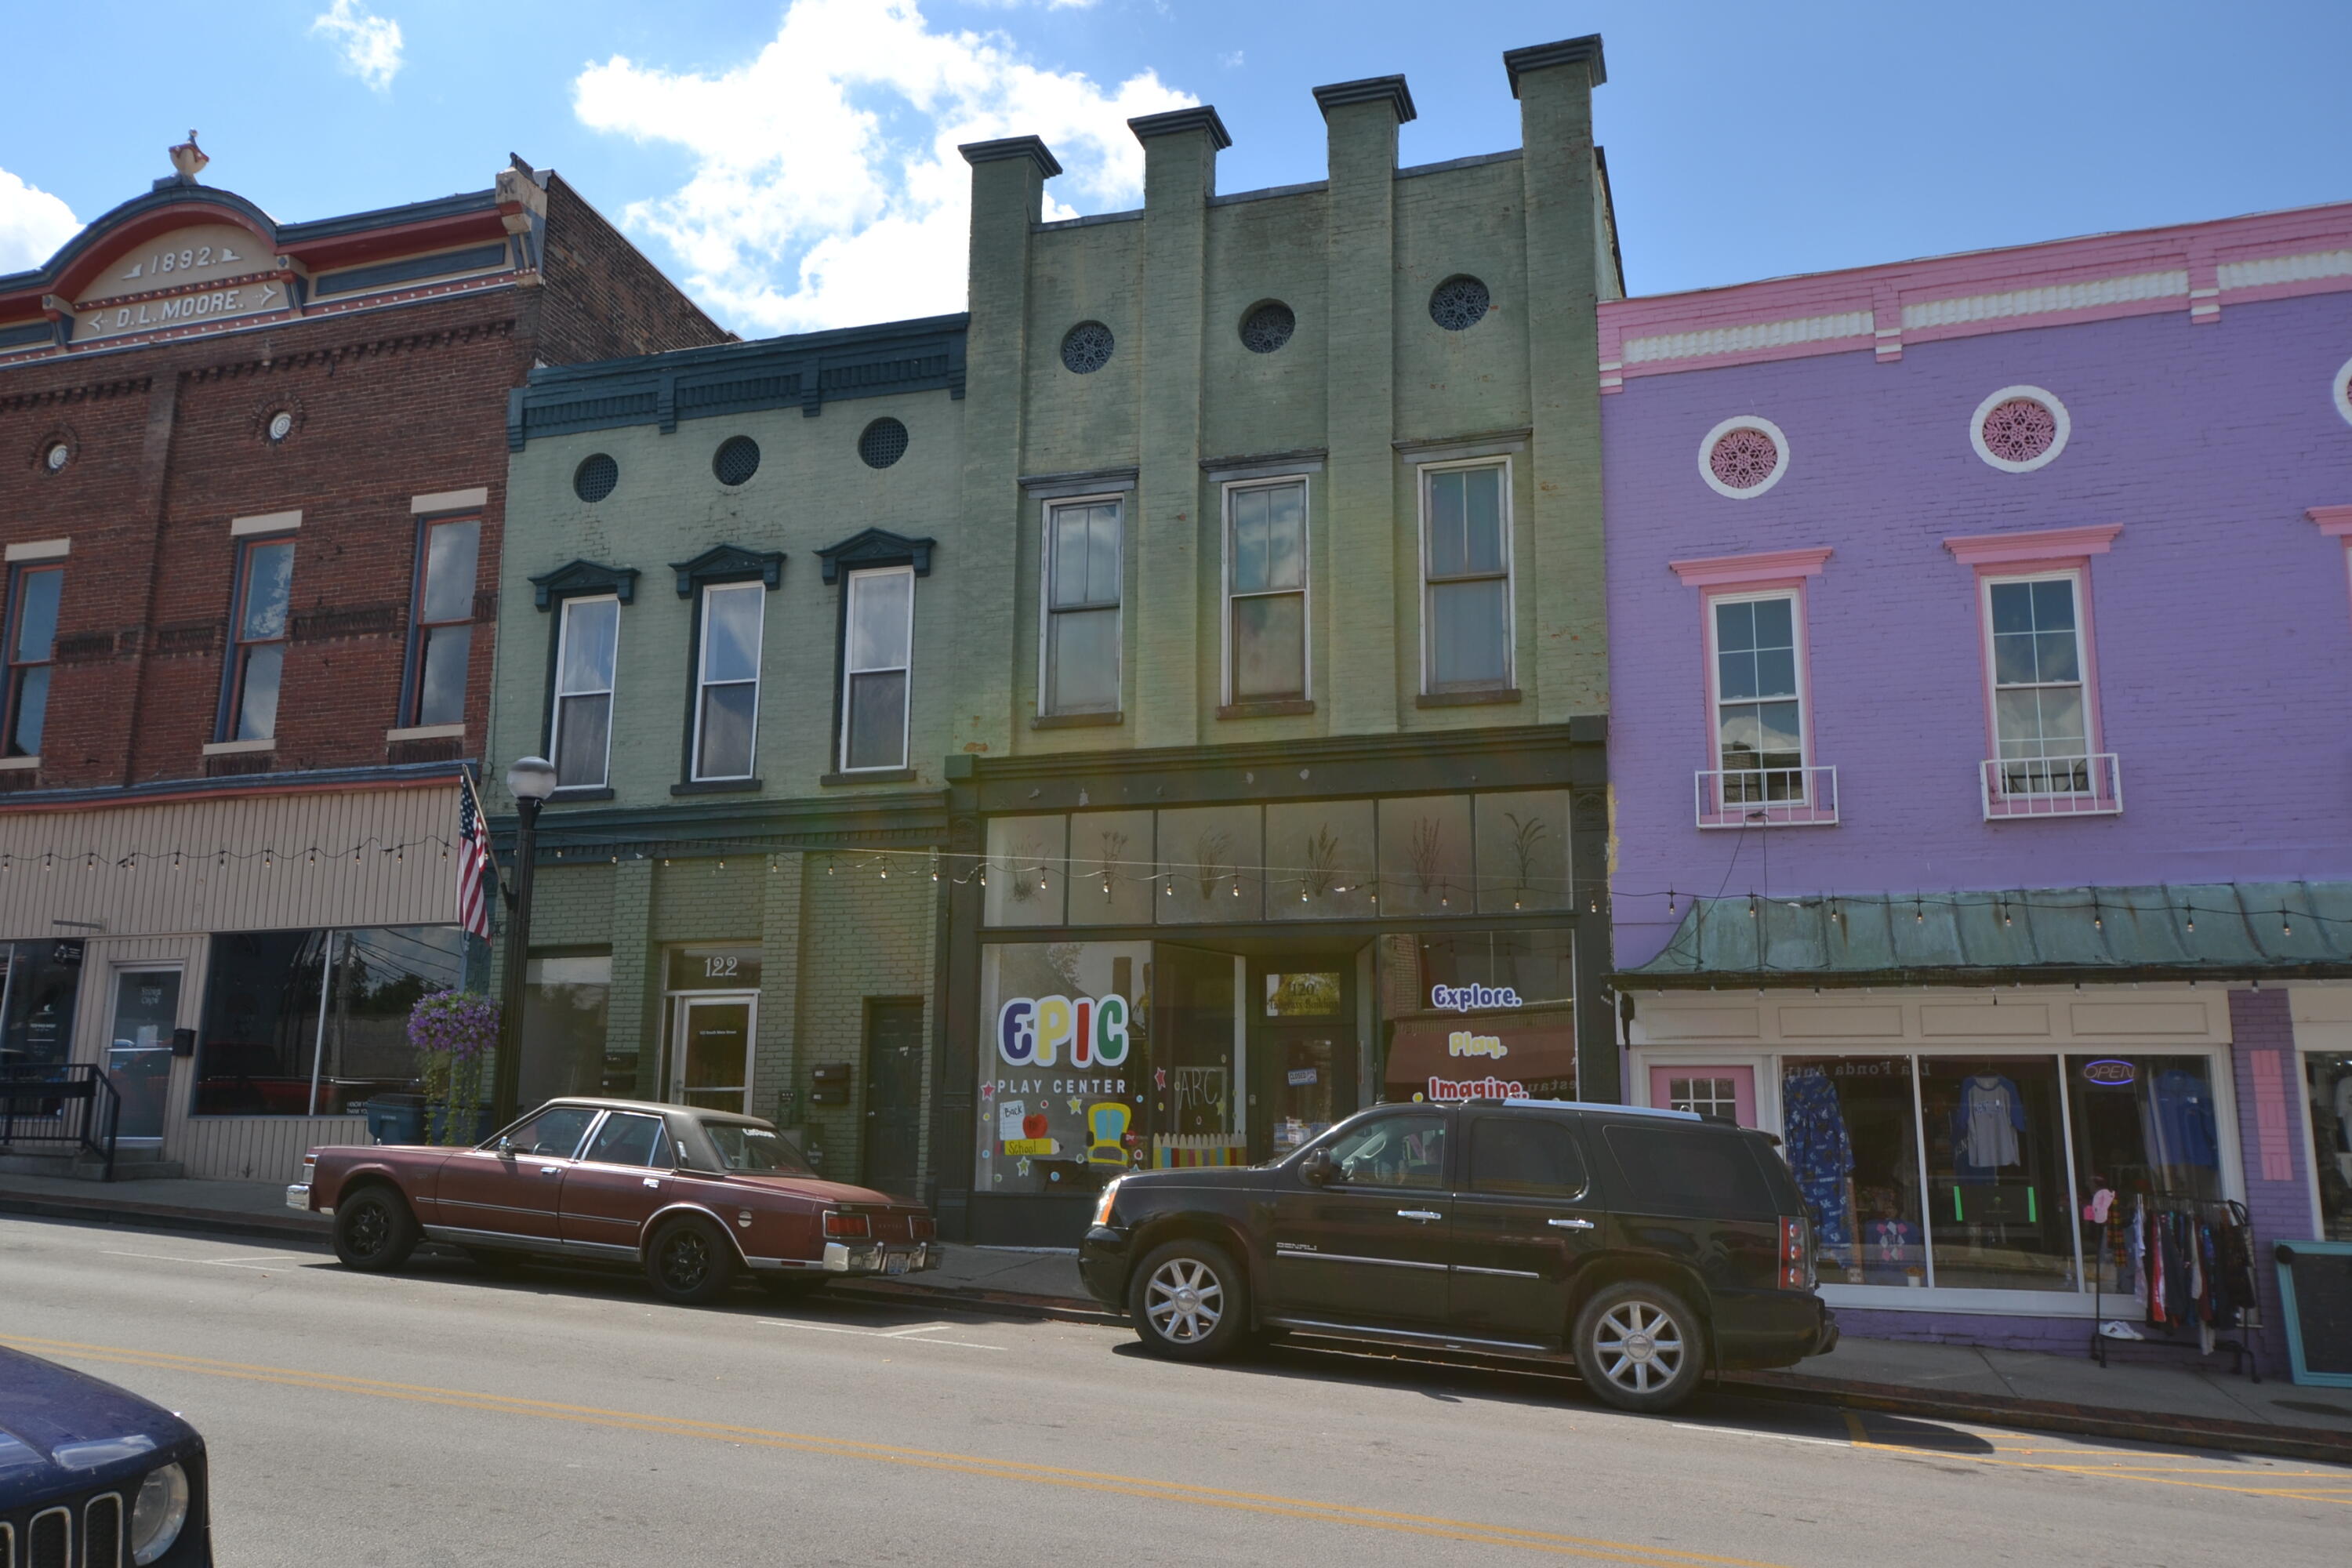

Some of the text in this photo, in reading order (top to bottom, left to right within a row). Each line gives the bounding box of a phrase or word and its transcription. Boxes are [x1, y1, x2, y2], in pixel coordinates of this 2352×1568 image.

[151, 246, 217, 274] 1892.
[161, 289, 245, 321] MOORE.
[704, 956, 739, 978] 122
[1291, 983, 1316, 996] 120
[1432, 983, 1523, 1013] Explore.
[998, 994, 1129, 1069] EPIC
[1449, 1031, 1508, 1059] Play.
[2083, 1065, 2136, 1080] OPEN
[997, 1080, 1127, 1094] PLAY CENTER
[1178, 1069, 1218, 1111] ABC
[1004, 1105, 1023, 1118] Back
[1008, 1141, 1036, 1155] School
[1276, 1242, 1318, 1251] DENALI
